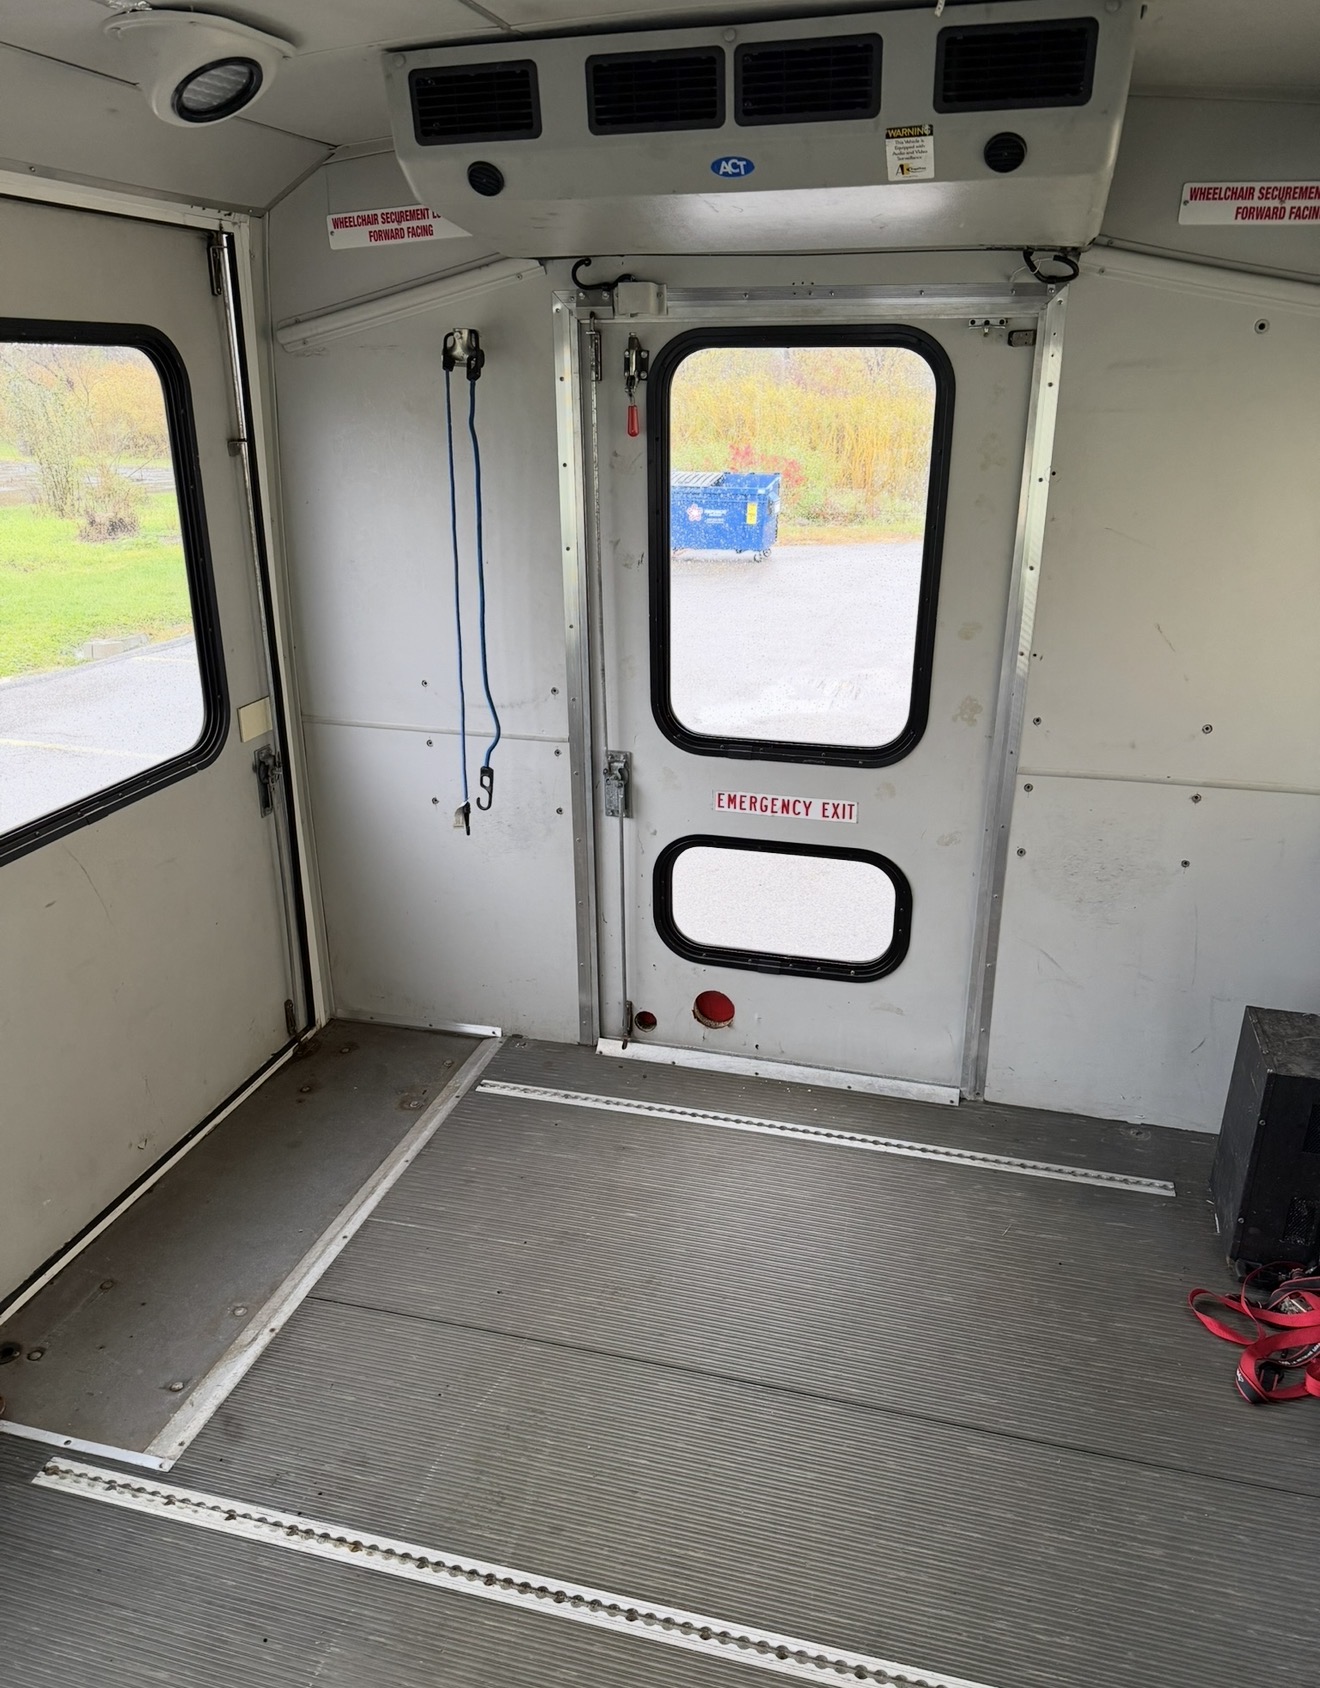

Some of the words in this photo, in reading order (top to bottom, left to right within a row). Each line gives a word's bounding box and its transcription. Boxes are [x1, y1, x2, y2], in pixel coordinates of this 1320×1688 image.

[888, 126, 930, 138] WARNING
[719, 159, 746, 175] ACT
[1189, 186, 1255, 201] WHEELCHAIR
[332, 214, 379, 229] WHEELCHAIR
[381, 208, 430, 224] SECUREMENT
[1234, 206, 1287, 220] FORWARD
[368, 227, 405, 242] FORWARD
[407, 224, 434, 239] FACING
[717, 792, 812, 816] EMERGENCY
[822, 802, 855, 820] EXIT
